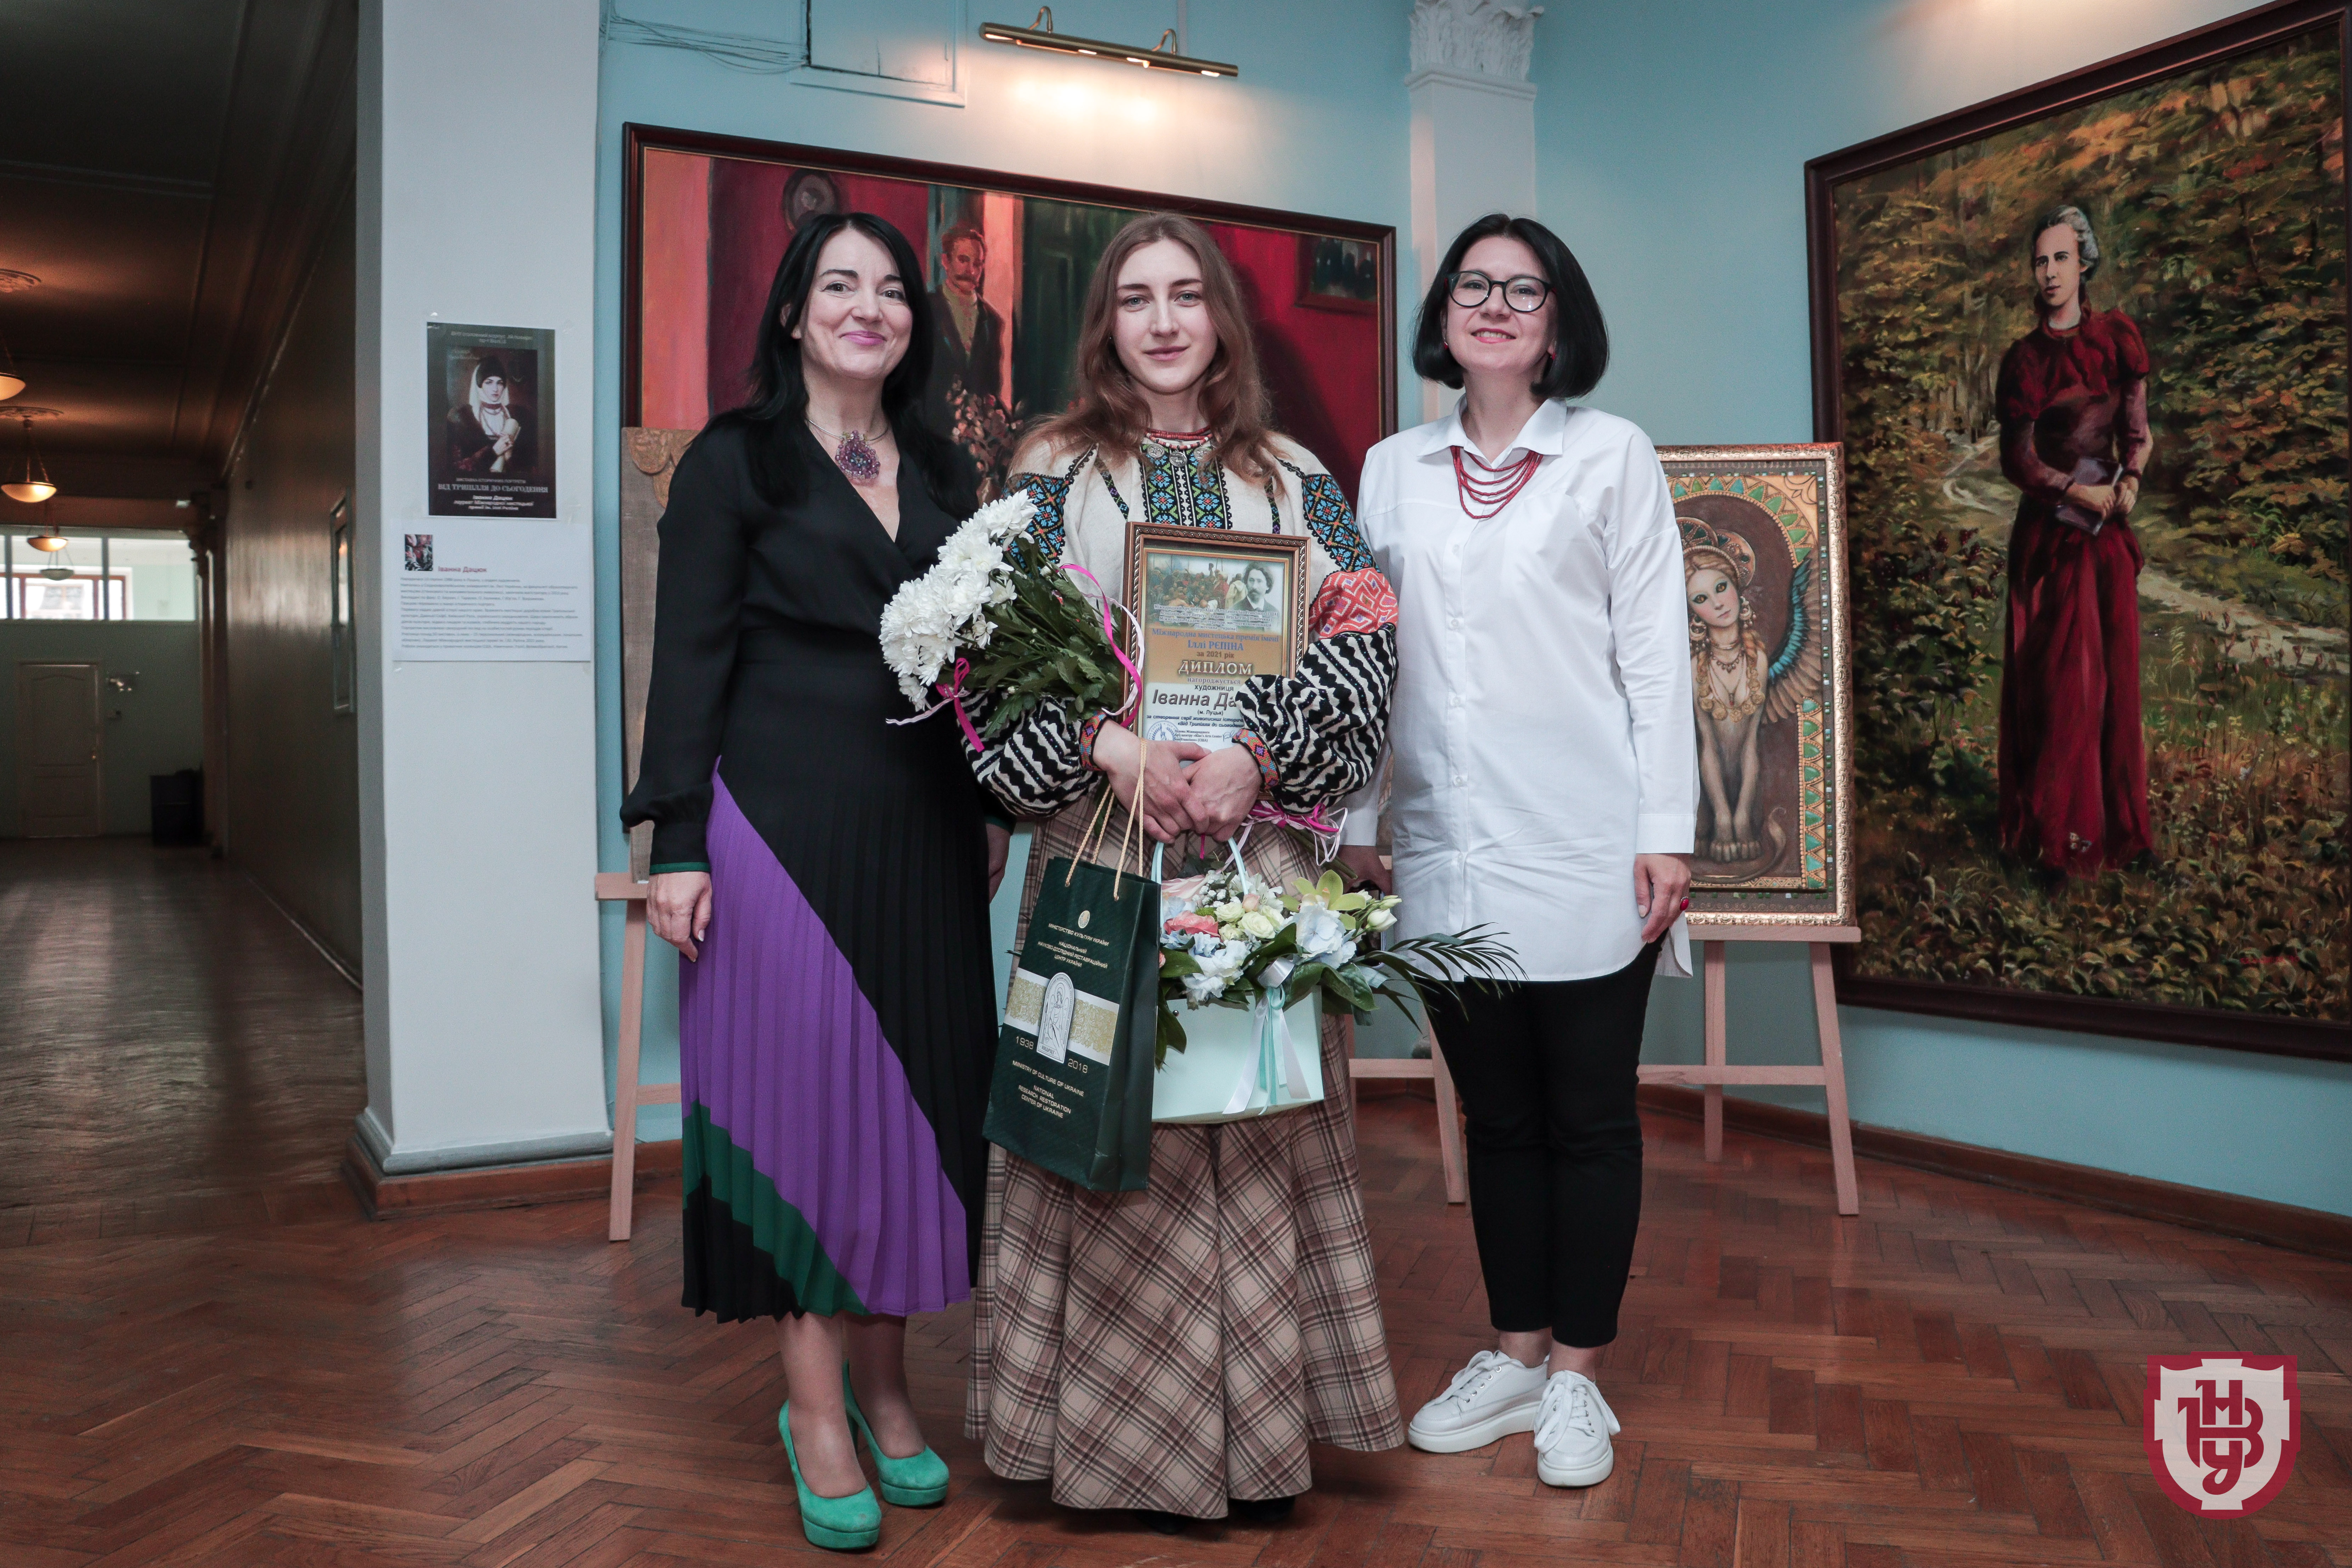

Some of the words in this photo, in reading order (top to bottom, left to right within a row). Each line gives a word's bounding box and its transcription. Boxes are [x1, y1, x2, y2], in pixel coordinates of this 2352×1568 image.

[1152, 628, 1196, 638] Міжнародна
[1188, 640, 1206, 648] Іллі
[1209, 641, 1244, 650] РЄПІНА
[1178, 660, 1252, 675] ДИПЛОМ
[1152, 689, 1210, 706] Іванна
[1213, 692, 1237, 711] Да
[1048, 923, 1074, 935] МІНІСТЕРСТВО
[1073, 931, 1093, 941] КУЛЬТУРИ
[1093, 937, 1109, 946] УКРАЇНИ
[1059, 941, 1087, 954] НАЦІОНАЛЬНИЙ
[1037, 941, 1074, 957] НАУКОВО-ДОСЛІДНИЙ
[1074, 953, 1108, 969] РЕСТАВРАЦІЙНИЙ
[1066, 958, 1082, 968] УКРАЇНИ
[1016, 1036, 1034, 1050] 1938
[1068, 1059, 1088, 1073] 2018
[1012, 1060, 1032, 1073] MINISTRY
[1038, 1072, 1056, 1084] CULTURE
[1064, 1084, 1084, 1097] UKRAINE
[1033, 1085, 1054, 1099] NATIONAL
[1018, 1085, 1038, 1099] RESEARCH
[1039, 1096, 1071, 1114] RESTORATION
[1021, 1094, 1036, 1105] CENTER
[1043, 1105, 1064, 1118] UKRAINE
